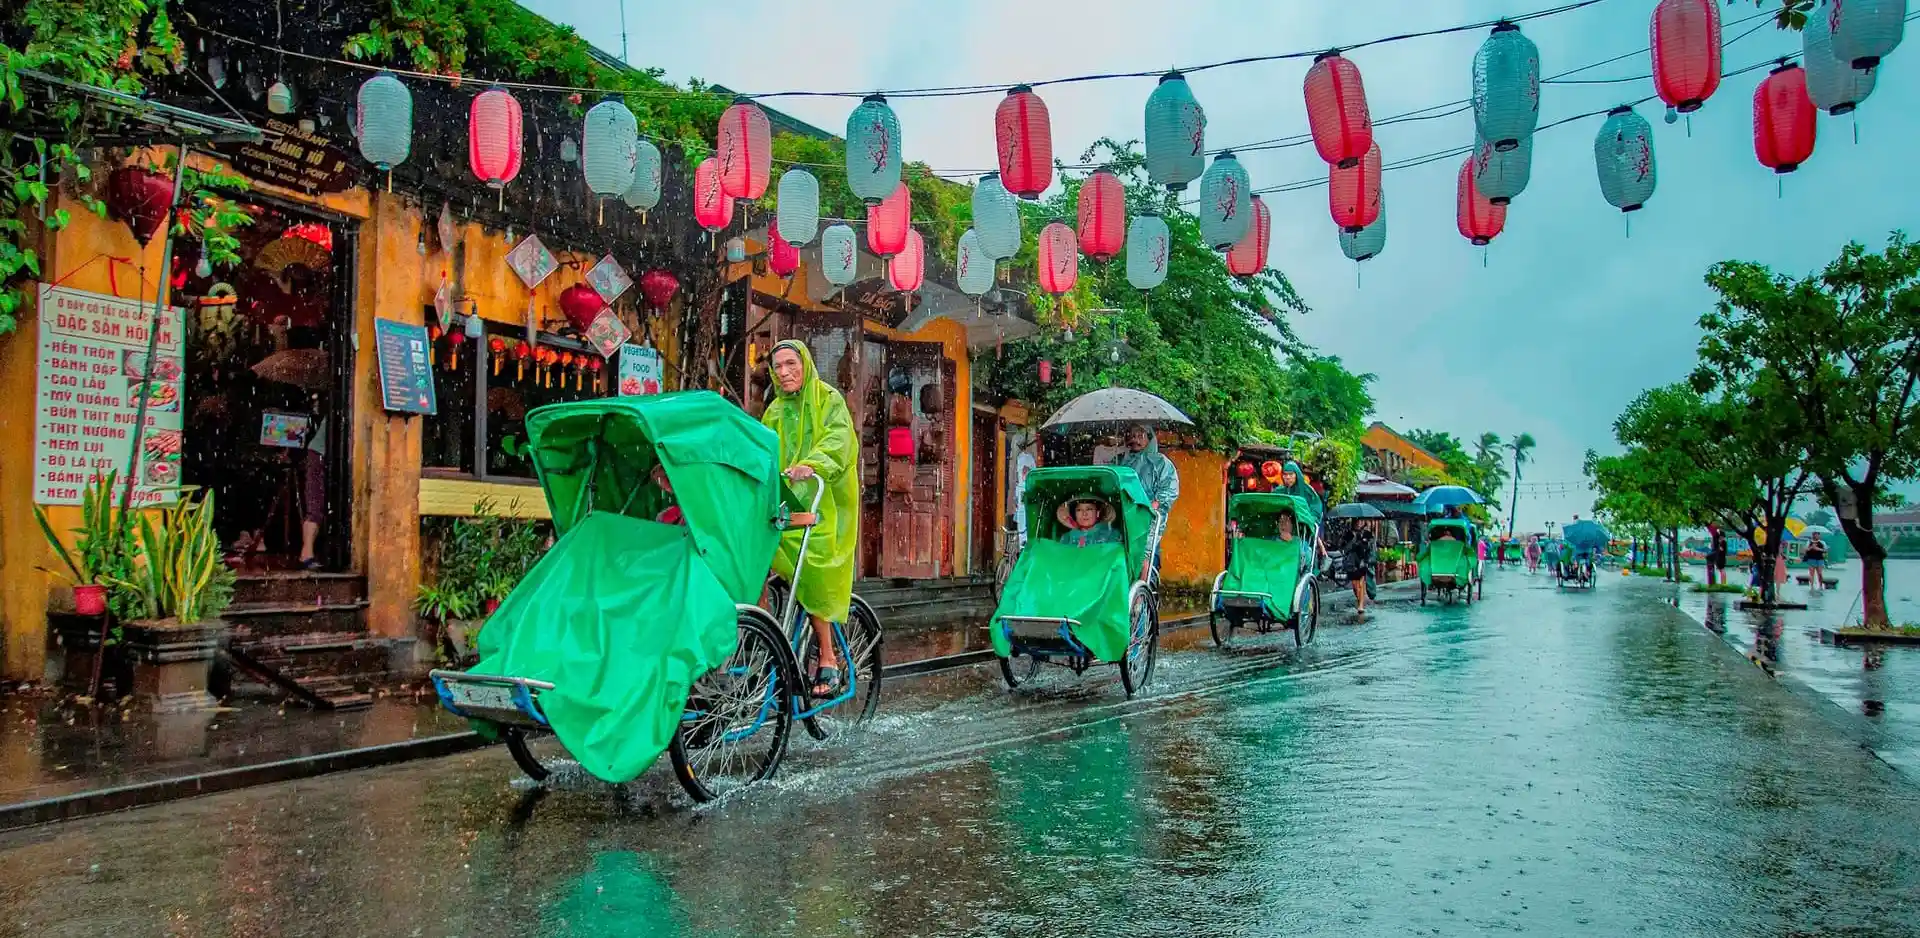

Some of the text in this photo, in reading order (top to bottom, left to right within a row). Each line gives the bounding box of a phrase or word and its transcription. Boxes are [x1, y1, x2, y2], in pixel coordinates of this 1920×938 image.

[304, 167, 331, 181] PORT
[57, 313, 87, 334] ĐẶC
[92, 317, 120, 337] SẢN
[126, 323, 148, 341] HỘI
[51, 356, 88, 372] BÁNH
[633, 363, 650, 373] FOOD
[51, 374, 77, 386] CAO
[50, 405, 77, 419] BÚN
[50, 422, 126, 439] THỊT NƯỚNG
[49, 439, 79, 451] NEM
[47, 470, 84, 484] BÁNH
[47, 488, 77, 499] NEM
